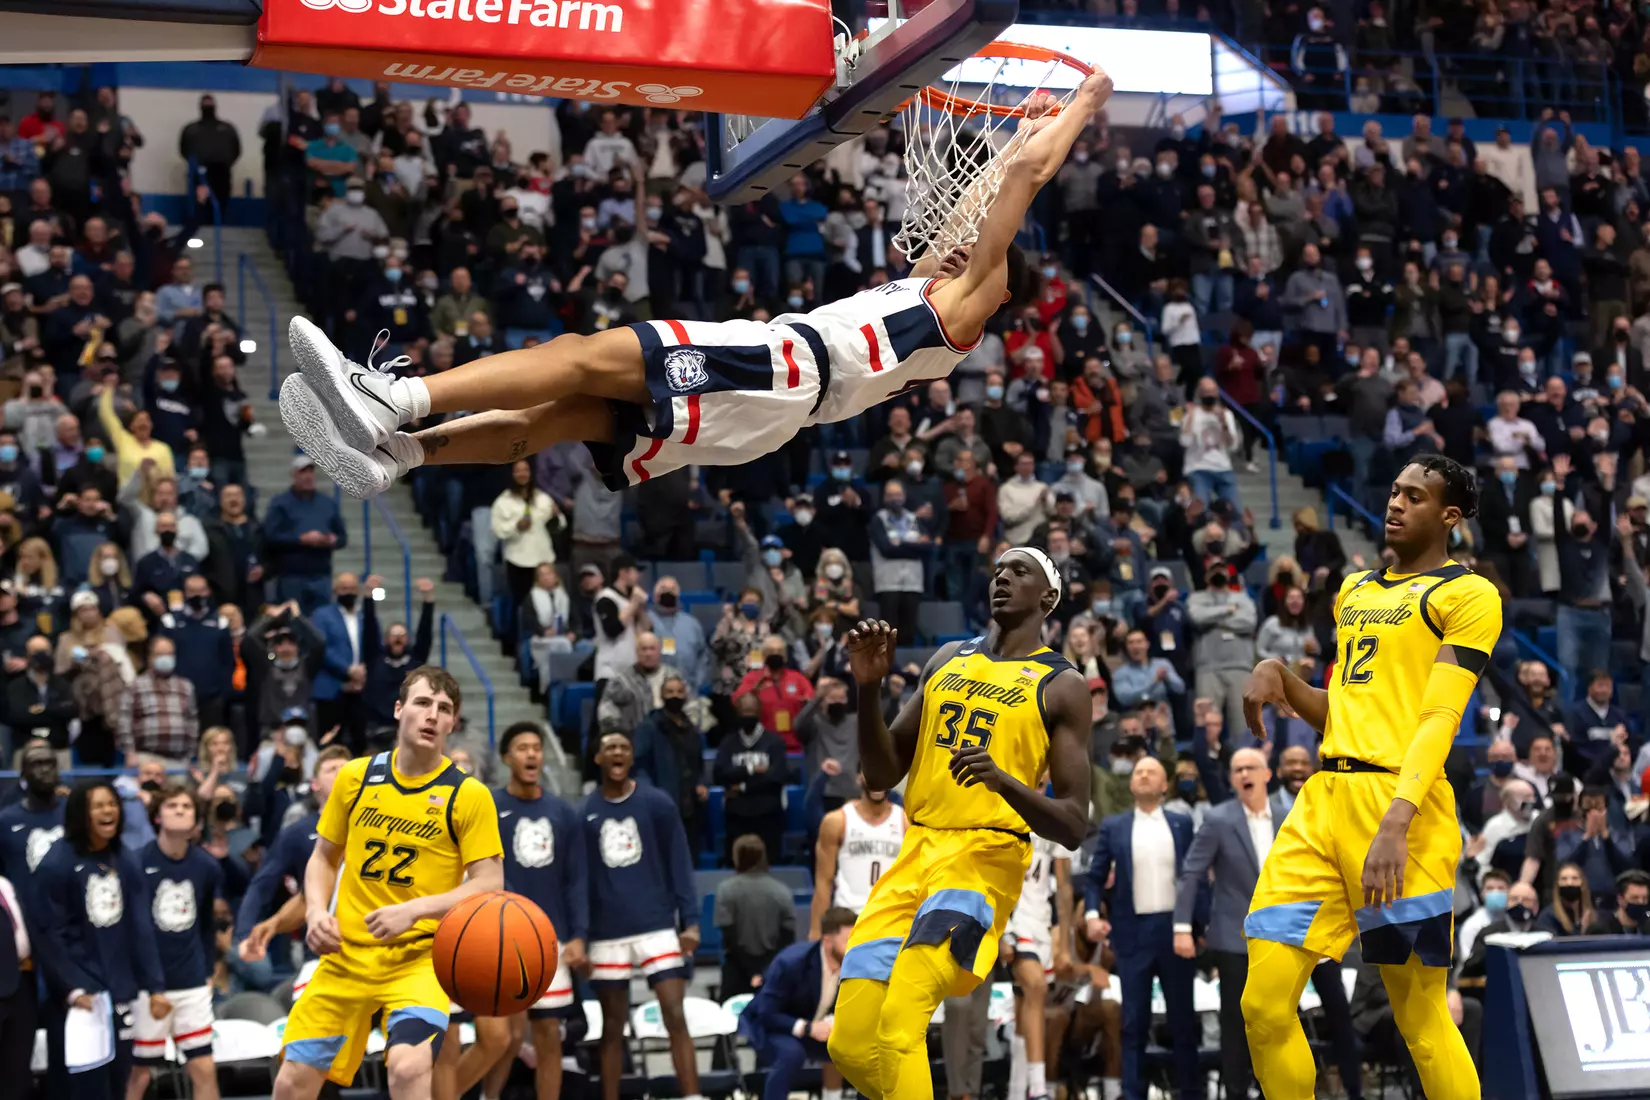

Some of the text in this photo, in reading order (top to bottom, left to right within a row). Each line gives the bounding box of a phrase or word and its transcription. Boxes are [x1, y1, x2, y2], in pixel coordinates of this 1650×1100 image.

[1340, 603, 1413, 632] Marquette
[1341, 635, 1379, 686] 12
[933, 672, 1028, 708] Marquette
[935, 700, 999, 751] 35
[355, 806, 443, 841] Marquette
[360, 838, 419, 888] 22
